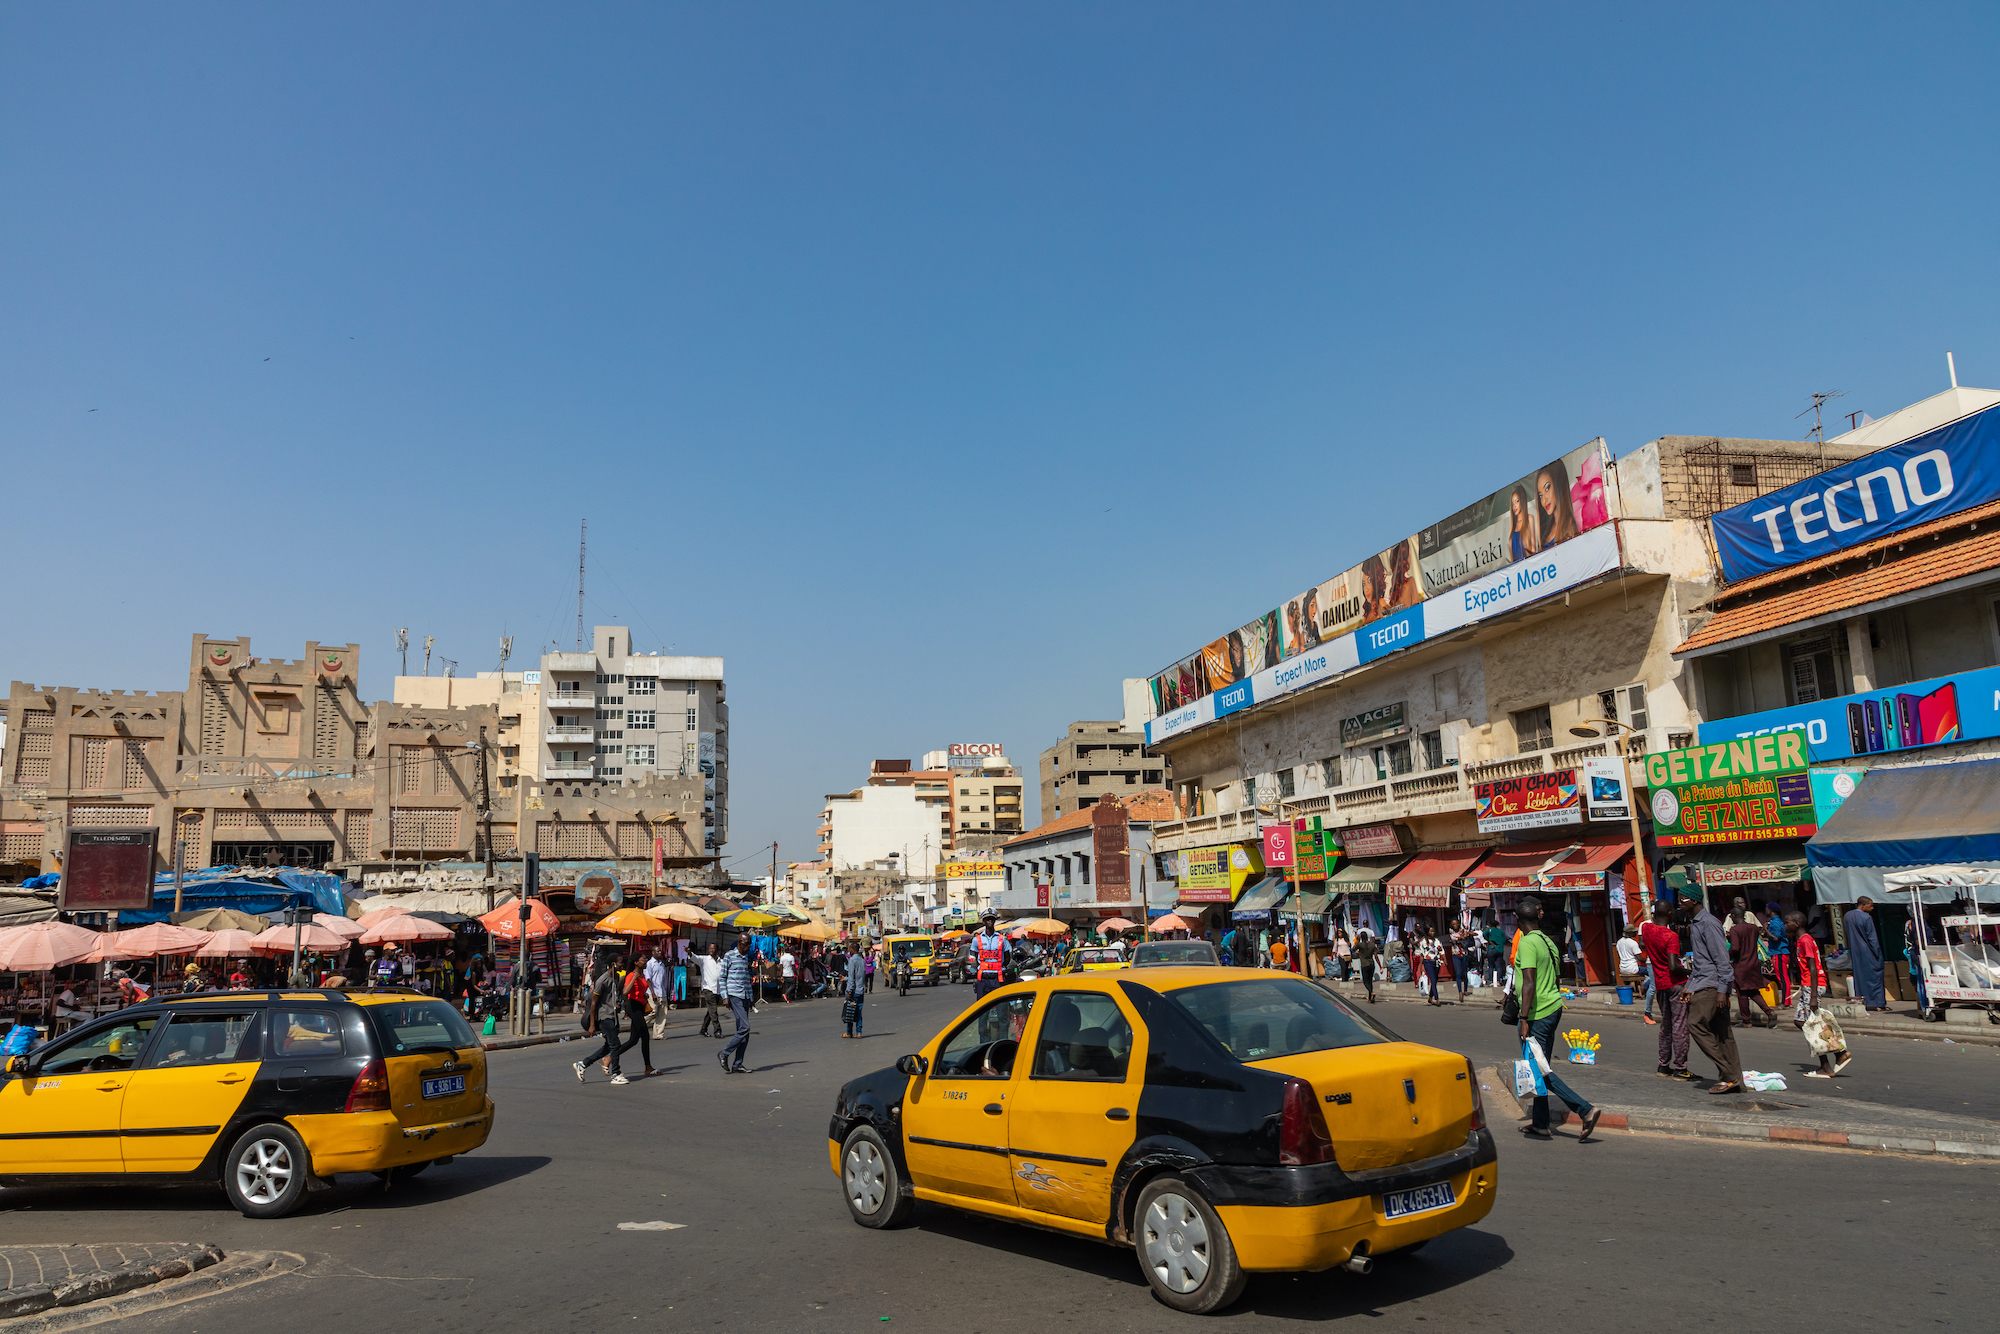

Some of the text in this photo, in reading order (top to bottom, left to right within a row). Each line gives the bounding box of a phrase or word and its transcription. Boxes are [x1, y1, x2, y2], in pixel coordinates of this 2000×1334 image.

[1752, 449, 1954, 554] TECNO
[1425, 537, 1503, 590] Natural Yaki
[1464, 563, 1557, 612] Expect More
[1322, 595, 1360, 629] DANIELA
[1369, 619, 1409, 649] TECNO
[1274, 655, 1326, 687] Expect More
[1221, 687, 1245, 708] TECNO
[1165, 709, 1196, 732] Expect More
[1363, 703, 1400, 724] ACEP
[951, 744, 1003, 755] RICOH
[1647, 733, 1805, 786] GETZNER
[1476, 769, 1572, 799] LE BON CHOIX
[1678, 776, 1775, 803] Le Prince du Bazin
[1492, 794, 1518, 815] Chez
[1681, 797, 1781, 833] GETZNER
[1342, 825, 1392, 841] LE BAZIN
[1690, 833, 1699, 844] 77
[1701, 832, 1715, 843] 378
[1716, 832, 1727, 842] 95
[1728, 831, 1738, 841] 18
[1744, 831, 1754, 839] 77
[1756, 829, 1772, 839] 515
[1773, 828, 1785, 838] 25
[1786, 827, 1798, 837] 93
[1272, 852, 1285, 861] LG
[1297, 843, 1314, 854] Bazin
[948, 864, 1004, 878] getzn
[1190, 863, 1218, 876] GETZNER
[1284, 854, 1325, 874] ZNER
[1711, 869, 1777, 882] Getzner
[1338, 882, 1375, 892] LE BAZIN
[1387, 884, 1406, 896] ETS
[1325, 1092, 1352, 1103] LOGAN
